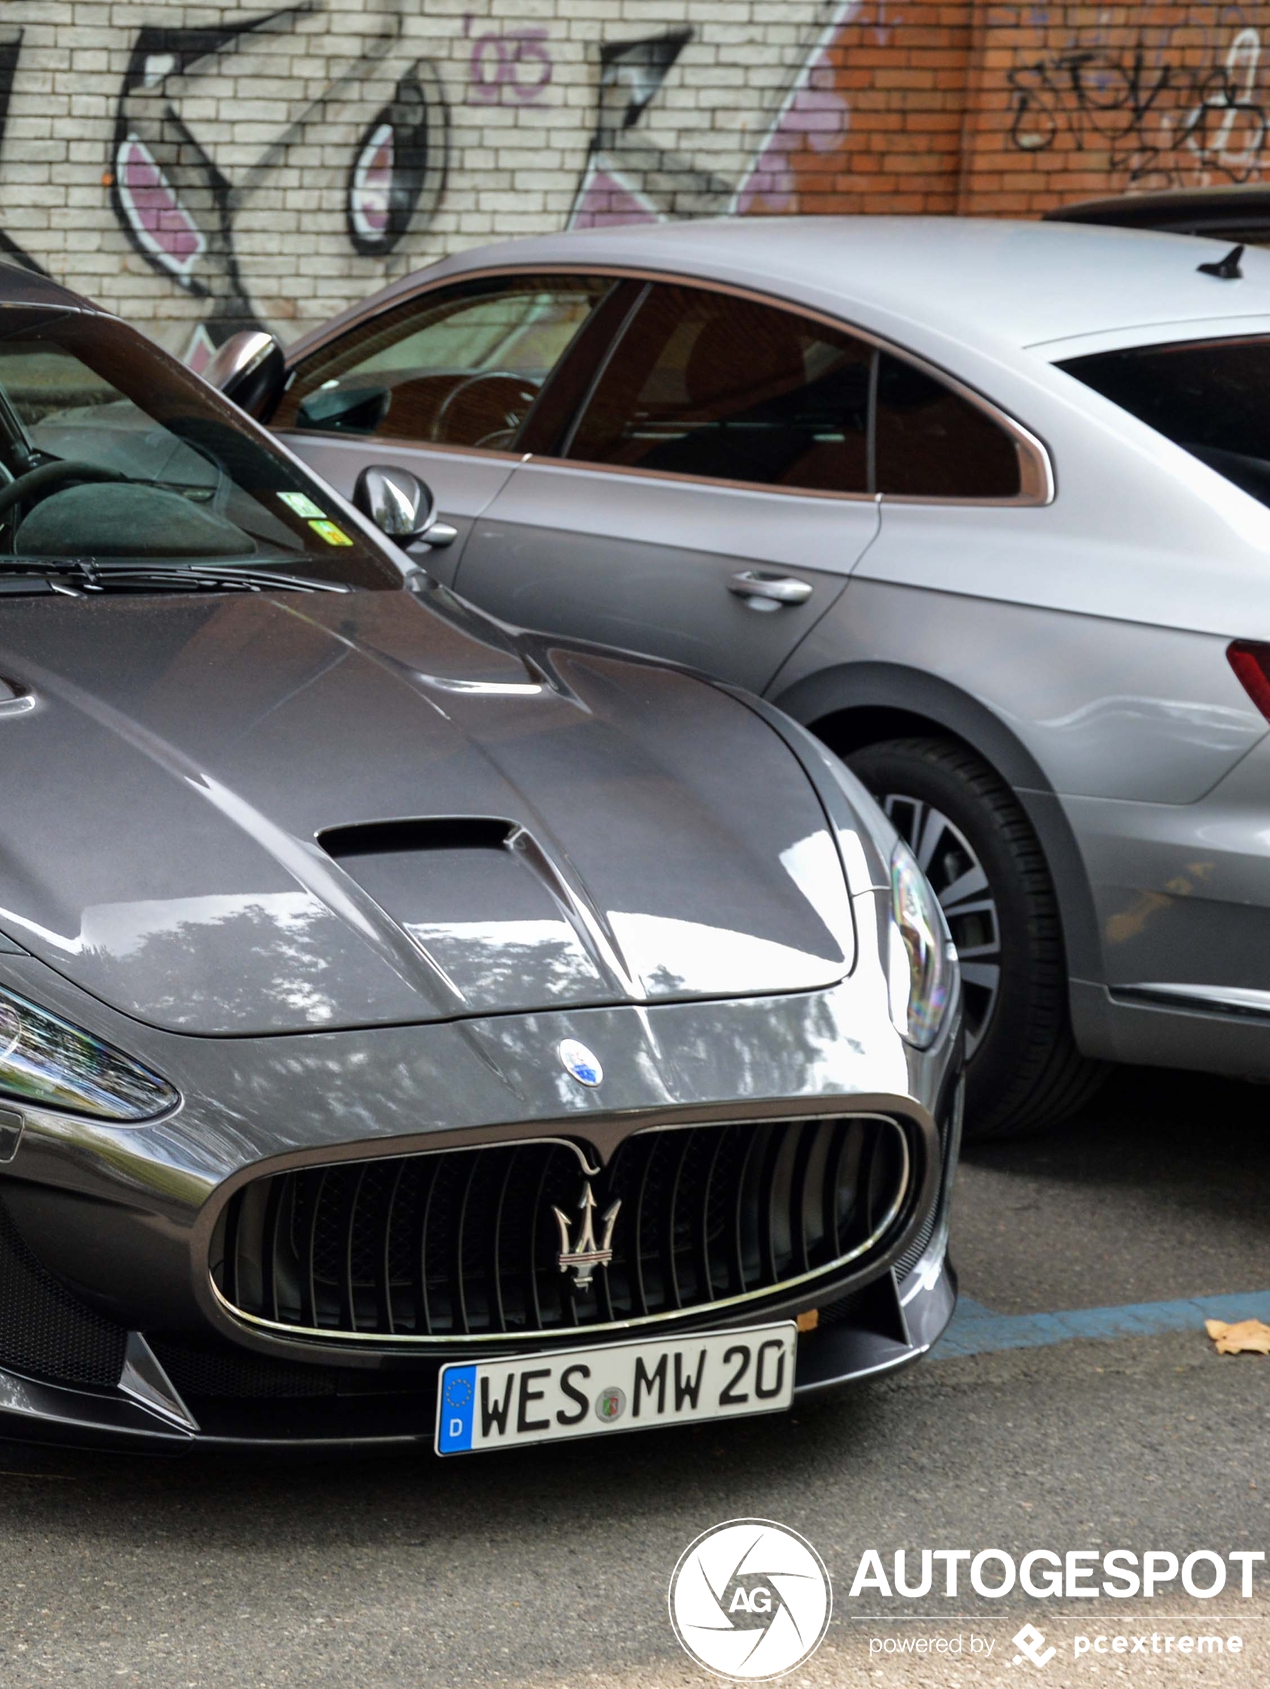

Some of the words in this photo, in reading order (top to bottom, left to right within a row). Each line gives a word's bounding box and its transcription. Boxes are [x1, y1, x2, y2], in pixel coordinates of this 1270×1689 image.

[480, 1364, 591, 1438] WES
[632, 1349, 707, 1418] MW
[719, 1339, 786, 1406] 20
[449, 1418, 463, 1438] D
